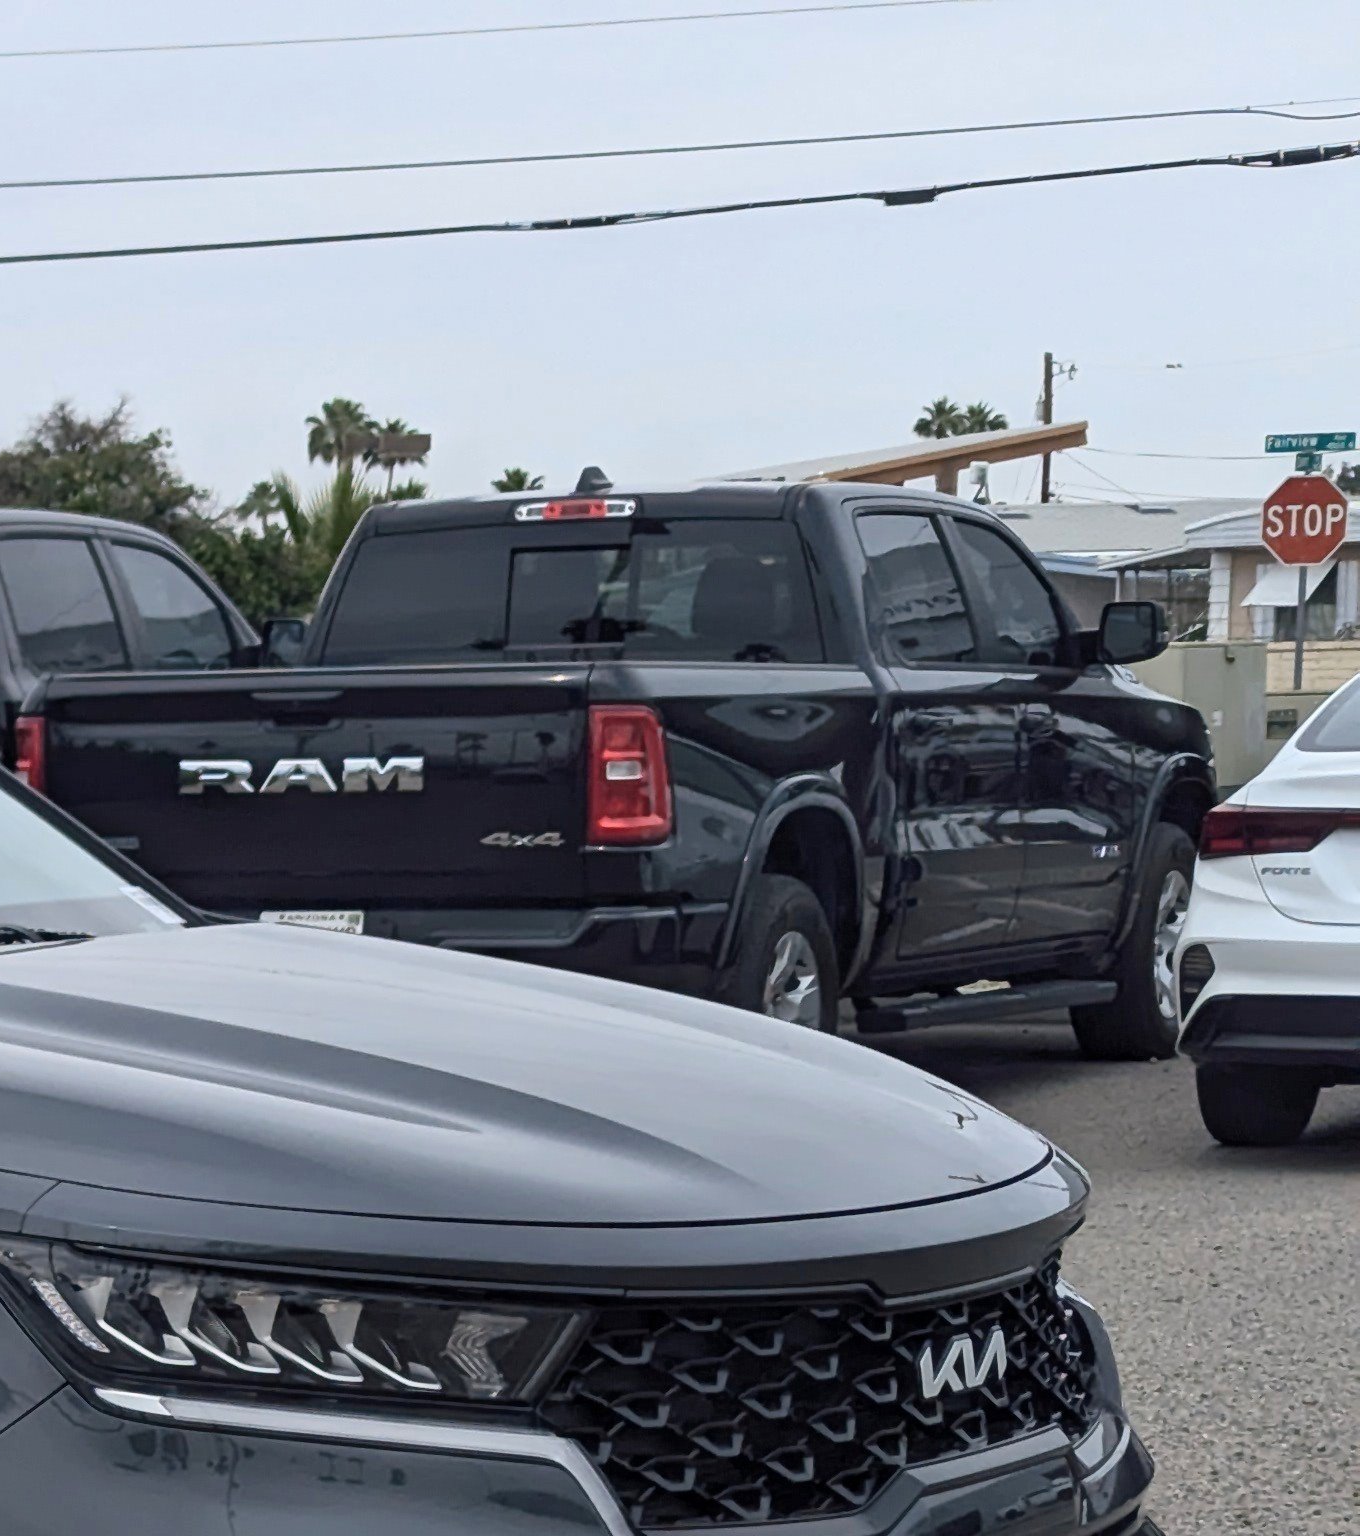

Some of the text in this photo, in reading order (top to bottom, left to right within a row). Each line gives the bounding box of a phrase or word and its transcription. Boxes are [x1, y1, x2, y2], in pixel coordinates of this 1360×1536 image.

[1266, 504, 1343, 537] STOP
[180, 756, 424, 795] RAM
[479, 832, 565, 847] 4x4
[1261, 867, 1311, 875] FORTE
[919, 1325, 1007, 1399] KIA
